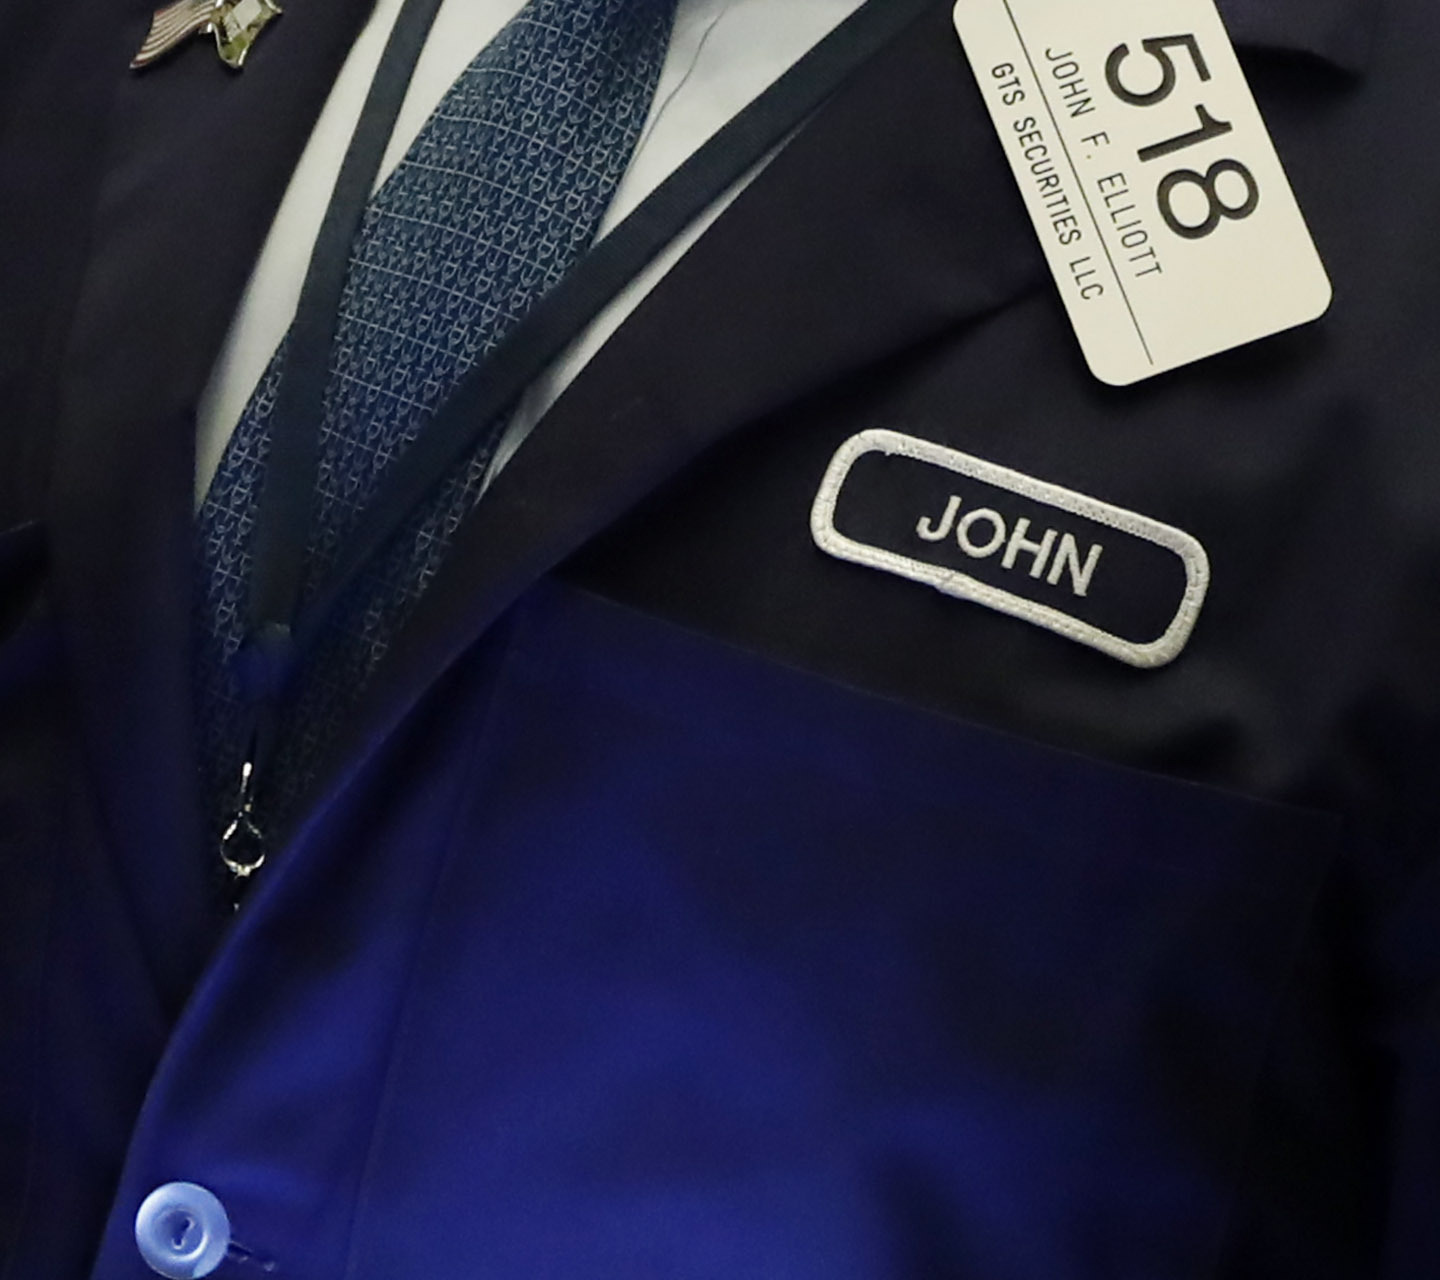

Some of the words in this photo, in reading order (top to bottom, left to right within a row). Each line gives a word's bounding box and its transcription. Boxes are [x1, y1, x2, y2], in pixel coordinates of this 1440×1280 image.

[991, 62, 1026, 107] GTS
[1013, 116, 1081, 246] SECURITIES
[1069, 256, 1104, 300] LLC
[1045, 46, 1096, 118] JOHN
[1081, 131, 1110, 161] F.
[1098, 172, 1163, 279] ELLIOTT
[1105, 33, 1259, 240] 518
[916, 495, 1103, 596] JOHN
